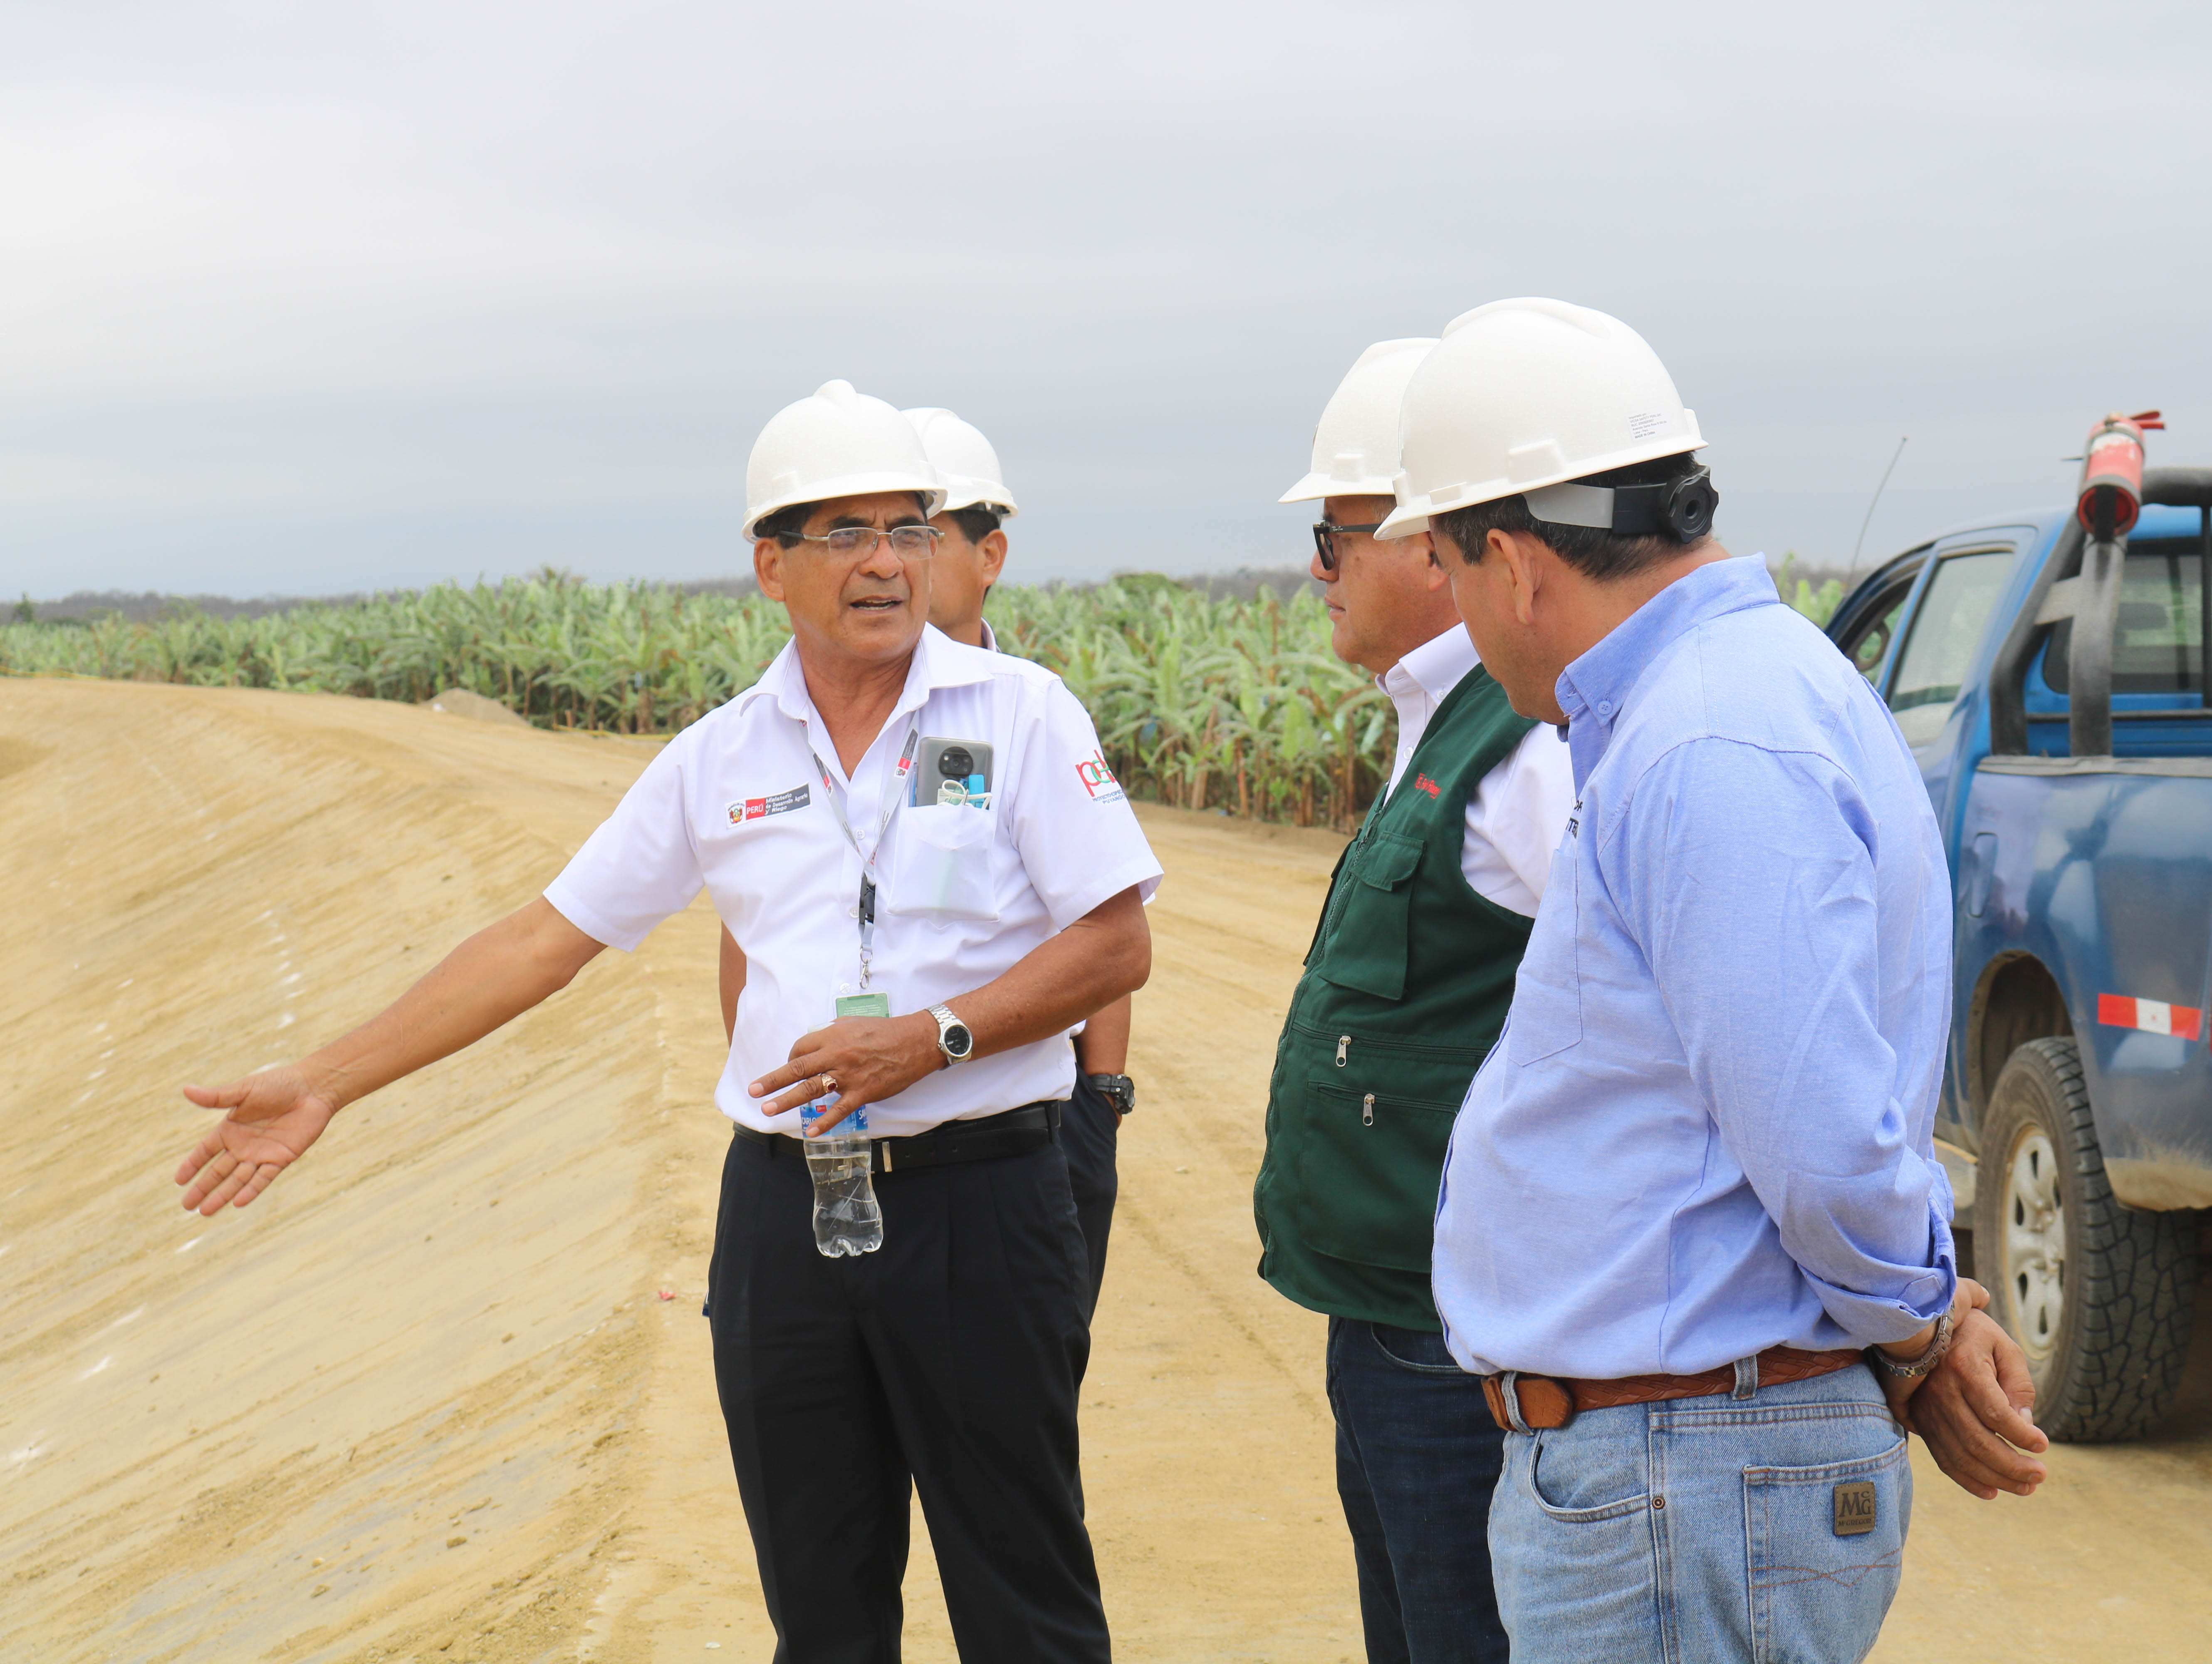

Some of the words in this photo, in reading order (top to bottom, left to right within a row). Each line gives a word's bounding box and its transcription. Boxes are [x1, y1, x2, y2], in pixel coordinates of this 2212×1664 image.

[766, 793, 792, 803] Ministerio
[772, 798, 793, 807] Desarrollo
[794, 792, 808, 802] Agrario
[747, 803, 764, 814] PERÚ
